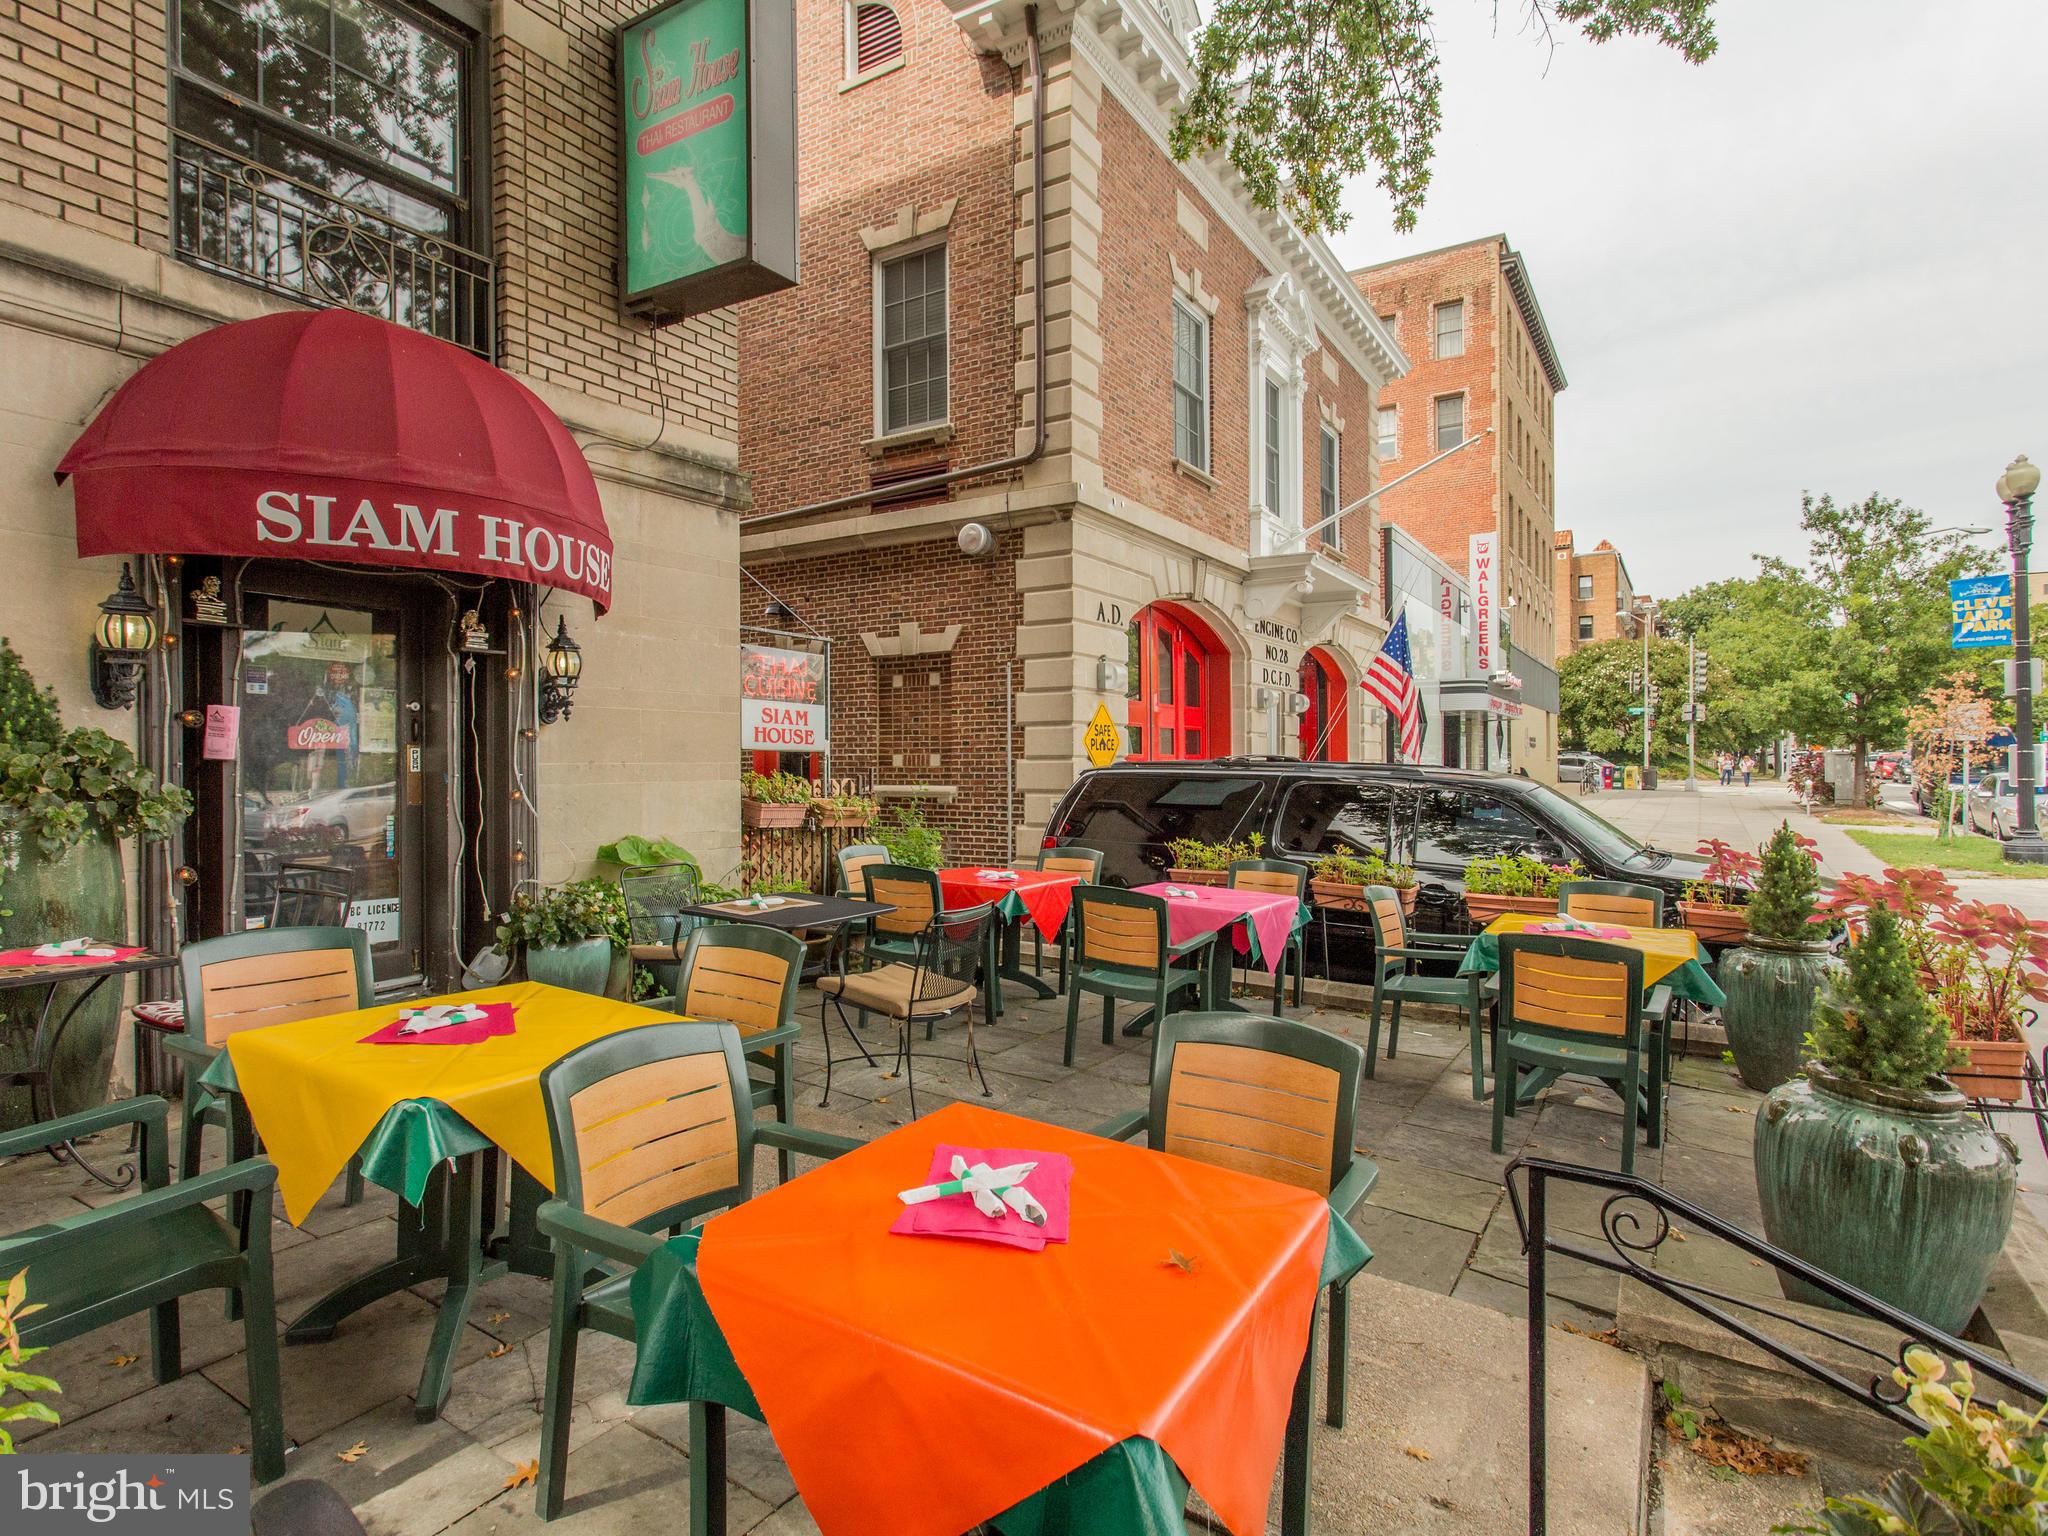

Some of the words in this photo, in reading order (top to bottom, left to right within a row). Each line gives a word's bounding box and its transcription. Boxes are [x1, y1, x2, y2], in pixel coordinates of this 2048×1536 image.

[685, 38, 740, 98] House
[641, 131, 662, 151] THAI
[665, 101, 730, 140] RESTAURANT
[256, 491, 459, 557] SIAM
[478, 514, 611, 593] HOUSE
[1096, 601, 1124, 626] A.D.
[1953, 596, 2014, 611] CLEVE
[1476, 558, 1491, 670] WALGREENS
[1953, 609, 2003, 624] LAND
[1255, 620, 1284, 641] ENGINE
[1286, 627, 1299, 645] CO.
[1962, 618, 2012, 633] PARK
[743, 674, 817, 701] CUISINE
[1263, 668, 1293, 688] D.C.F.D.
[761, 707, 809, 727] SIAM
[297, 726, 344, 748] Open
[753, 726, 815, 745] HOUSE
[1094, 724, 1111, 737] SAFE
[1090, 738, 1115, 751] PLACE
[350, 906, 361, 917] BC
